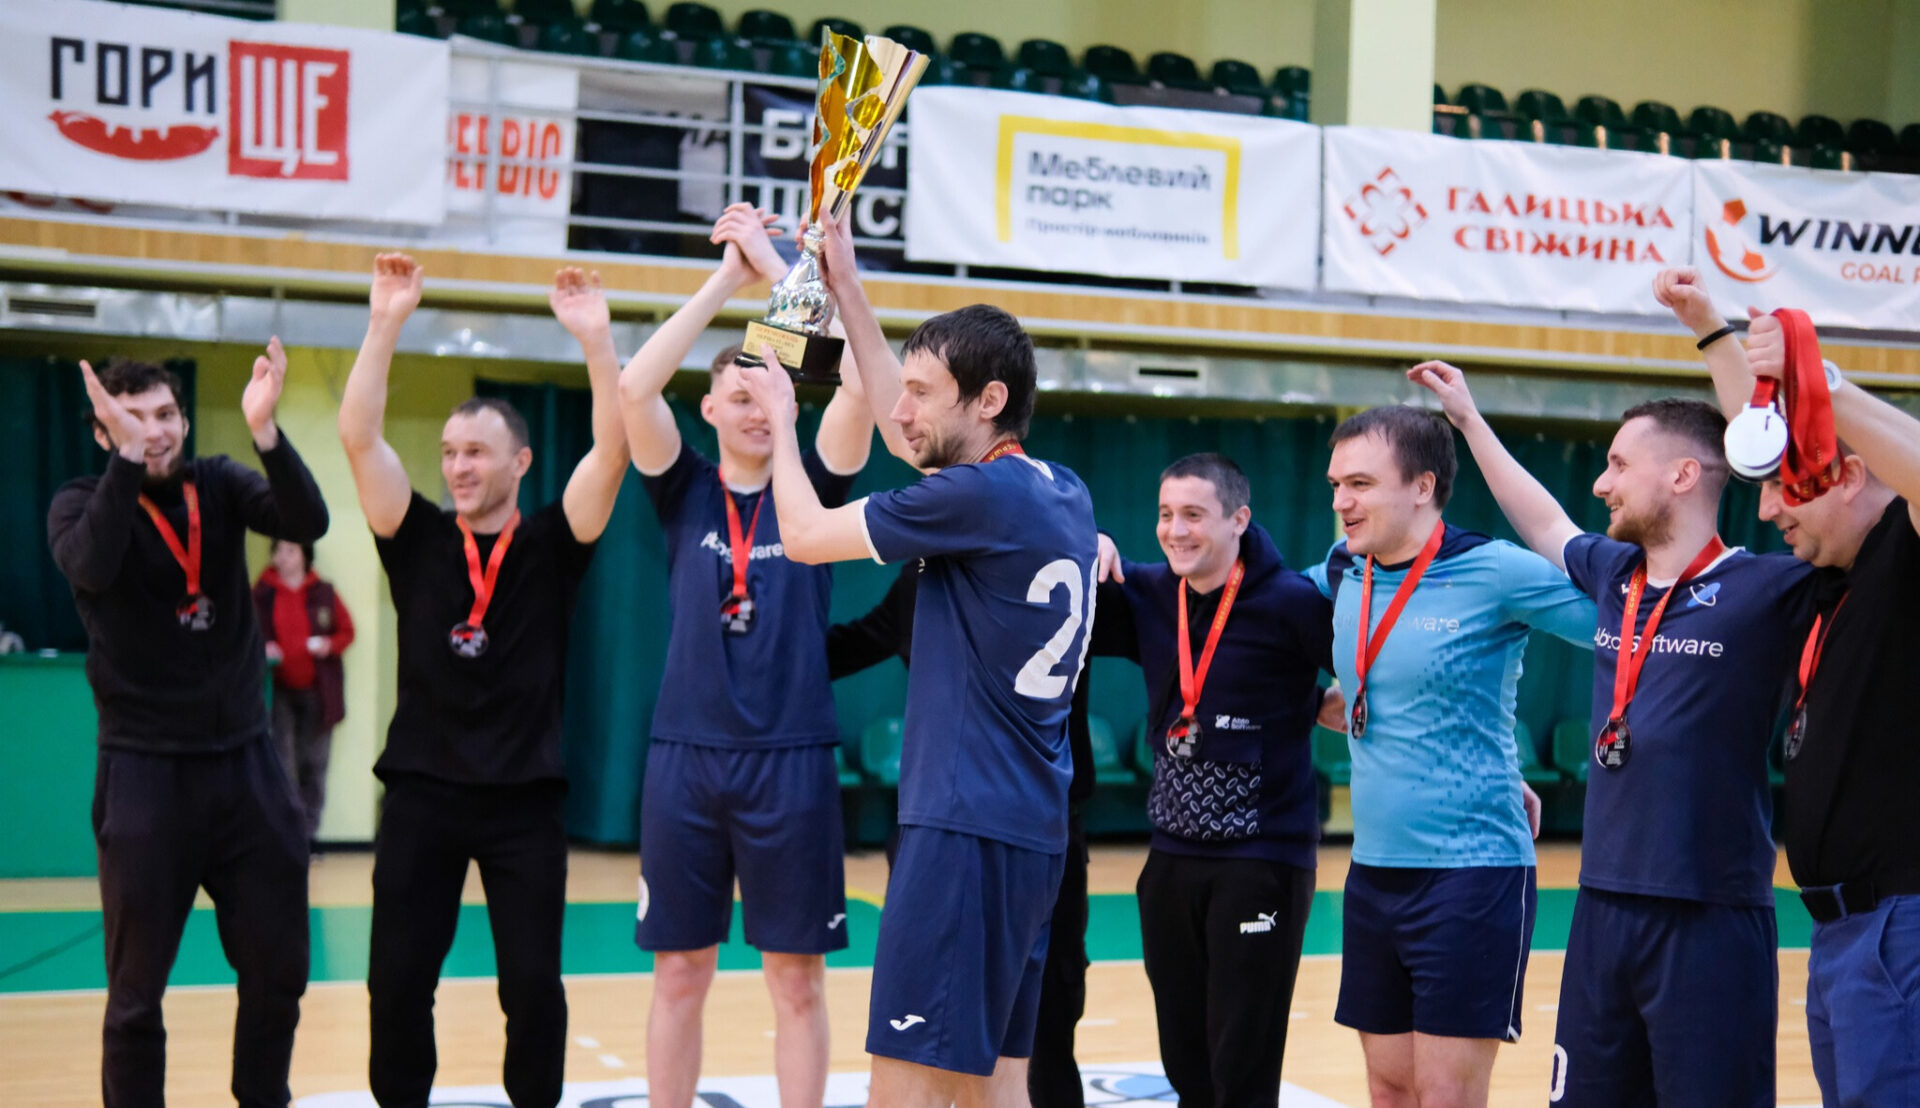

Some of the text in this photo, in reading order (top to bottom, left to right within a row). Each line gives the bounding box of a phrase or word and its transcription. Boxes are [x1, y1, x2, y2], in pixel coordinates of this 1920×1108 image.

[1028, 151, 1211, 190] Меблевий
[1026, 184, 1113, 211] парк
[1447, 186, 1675, 229] ГАЛИЦЬКА
[1453, 224, 1666, 263] СВІЖИНА
[1841, 261, 1905, 285] GOAL
[1631, 634, 1724, 657] Sftware
[1239, 920, 1272, 934] PUMA
